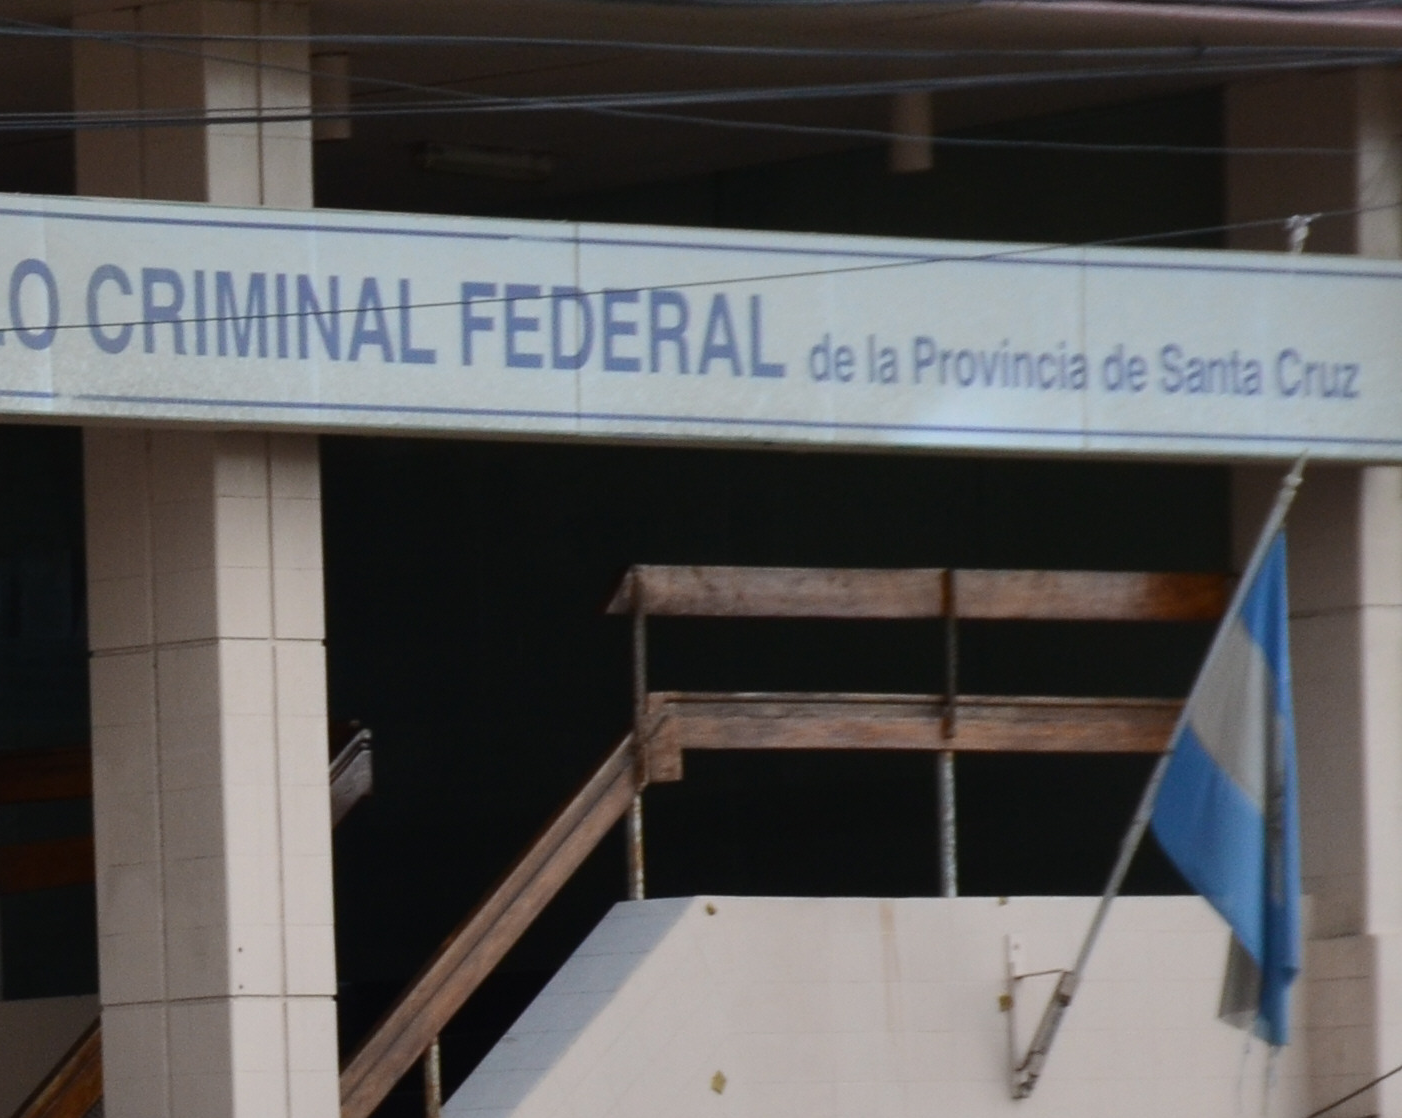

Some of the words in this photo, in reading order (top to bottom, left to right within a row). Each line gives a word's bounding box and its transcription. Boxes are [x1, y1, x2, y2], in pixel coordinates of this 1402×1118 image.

[86, 263, 438, 367] CRIMINAL
[459, 281, 787, 380] FEDERAL
[808, 332, 858, 385] de
[868, 334, 900, 386] la
[914, 336, 1087, 392] Provincia
[1102, 341, 1148, 394] de
[1158, 344, 1264, 399] Santa
[1273, 348, 1362, 401] Cruz
